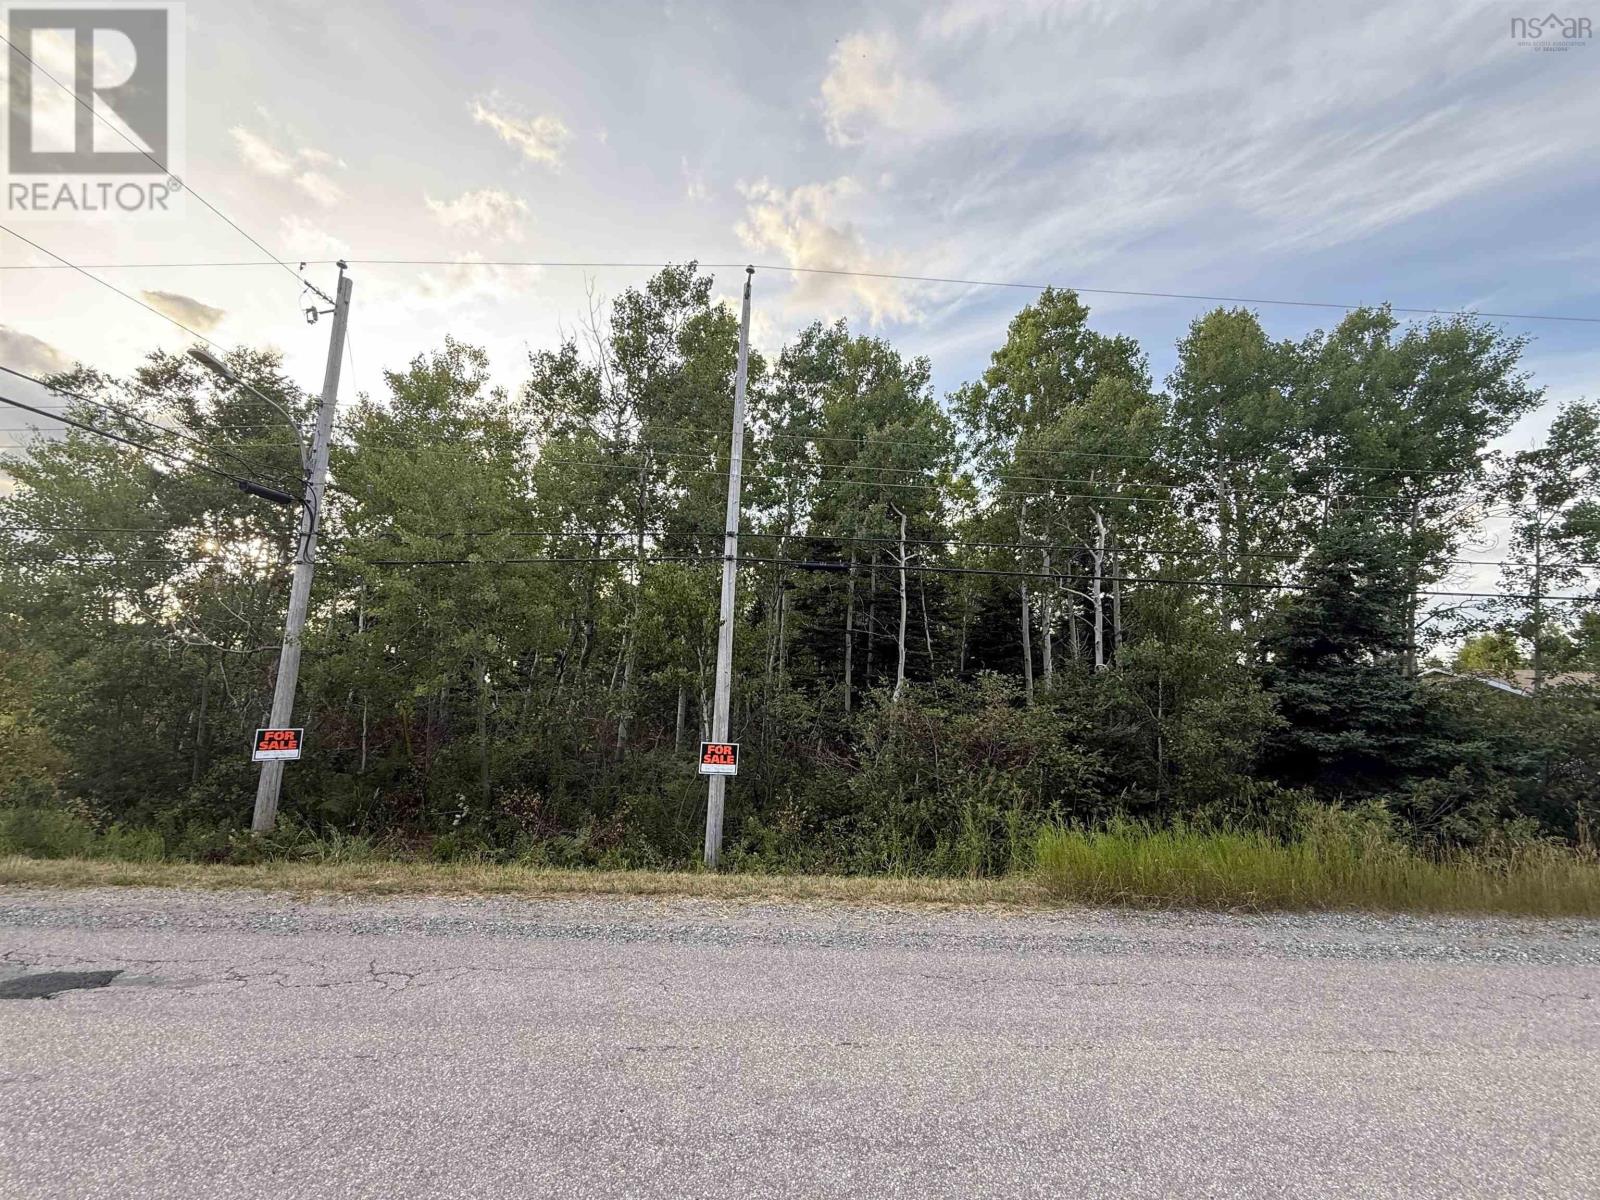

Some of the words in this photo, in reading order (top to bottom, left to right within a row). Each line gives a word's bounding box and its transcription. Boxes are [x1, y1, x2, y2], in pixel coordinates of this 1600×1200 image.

[264, 731, 295, 740] FOR
[258, 740, 298, 750] SALE
[707, 745, 732, 755] FOR
[703, 754, 735, 764] SALE
